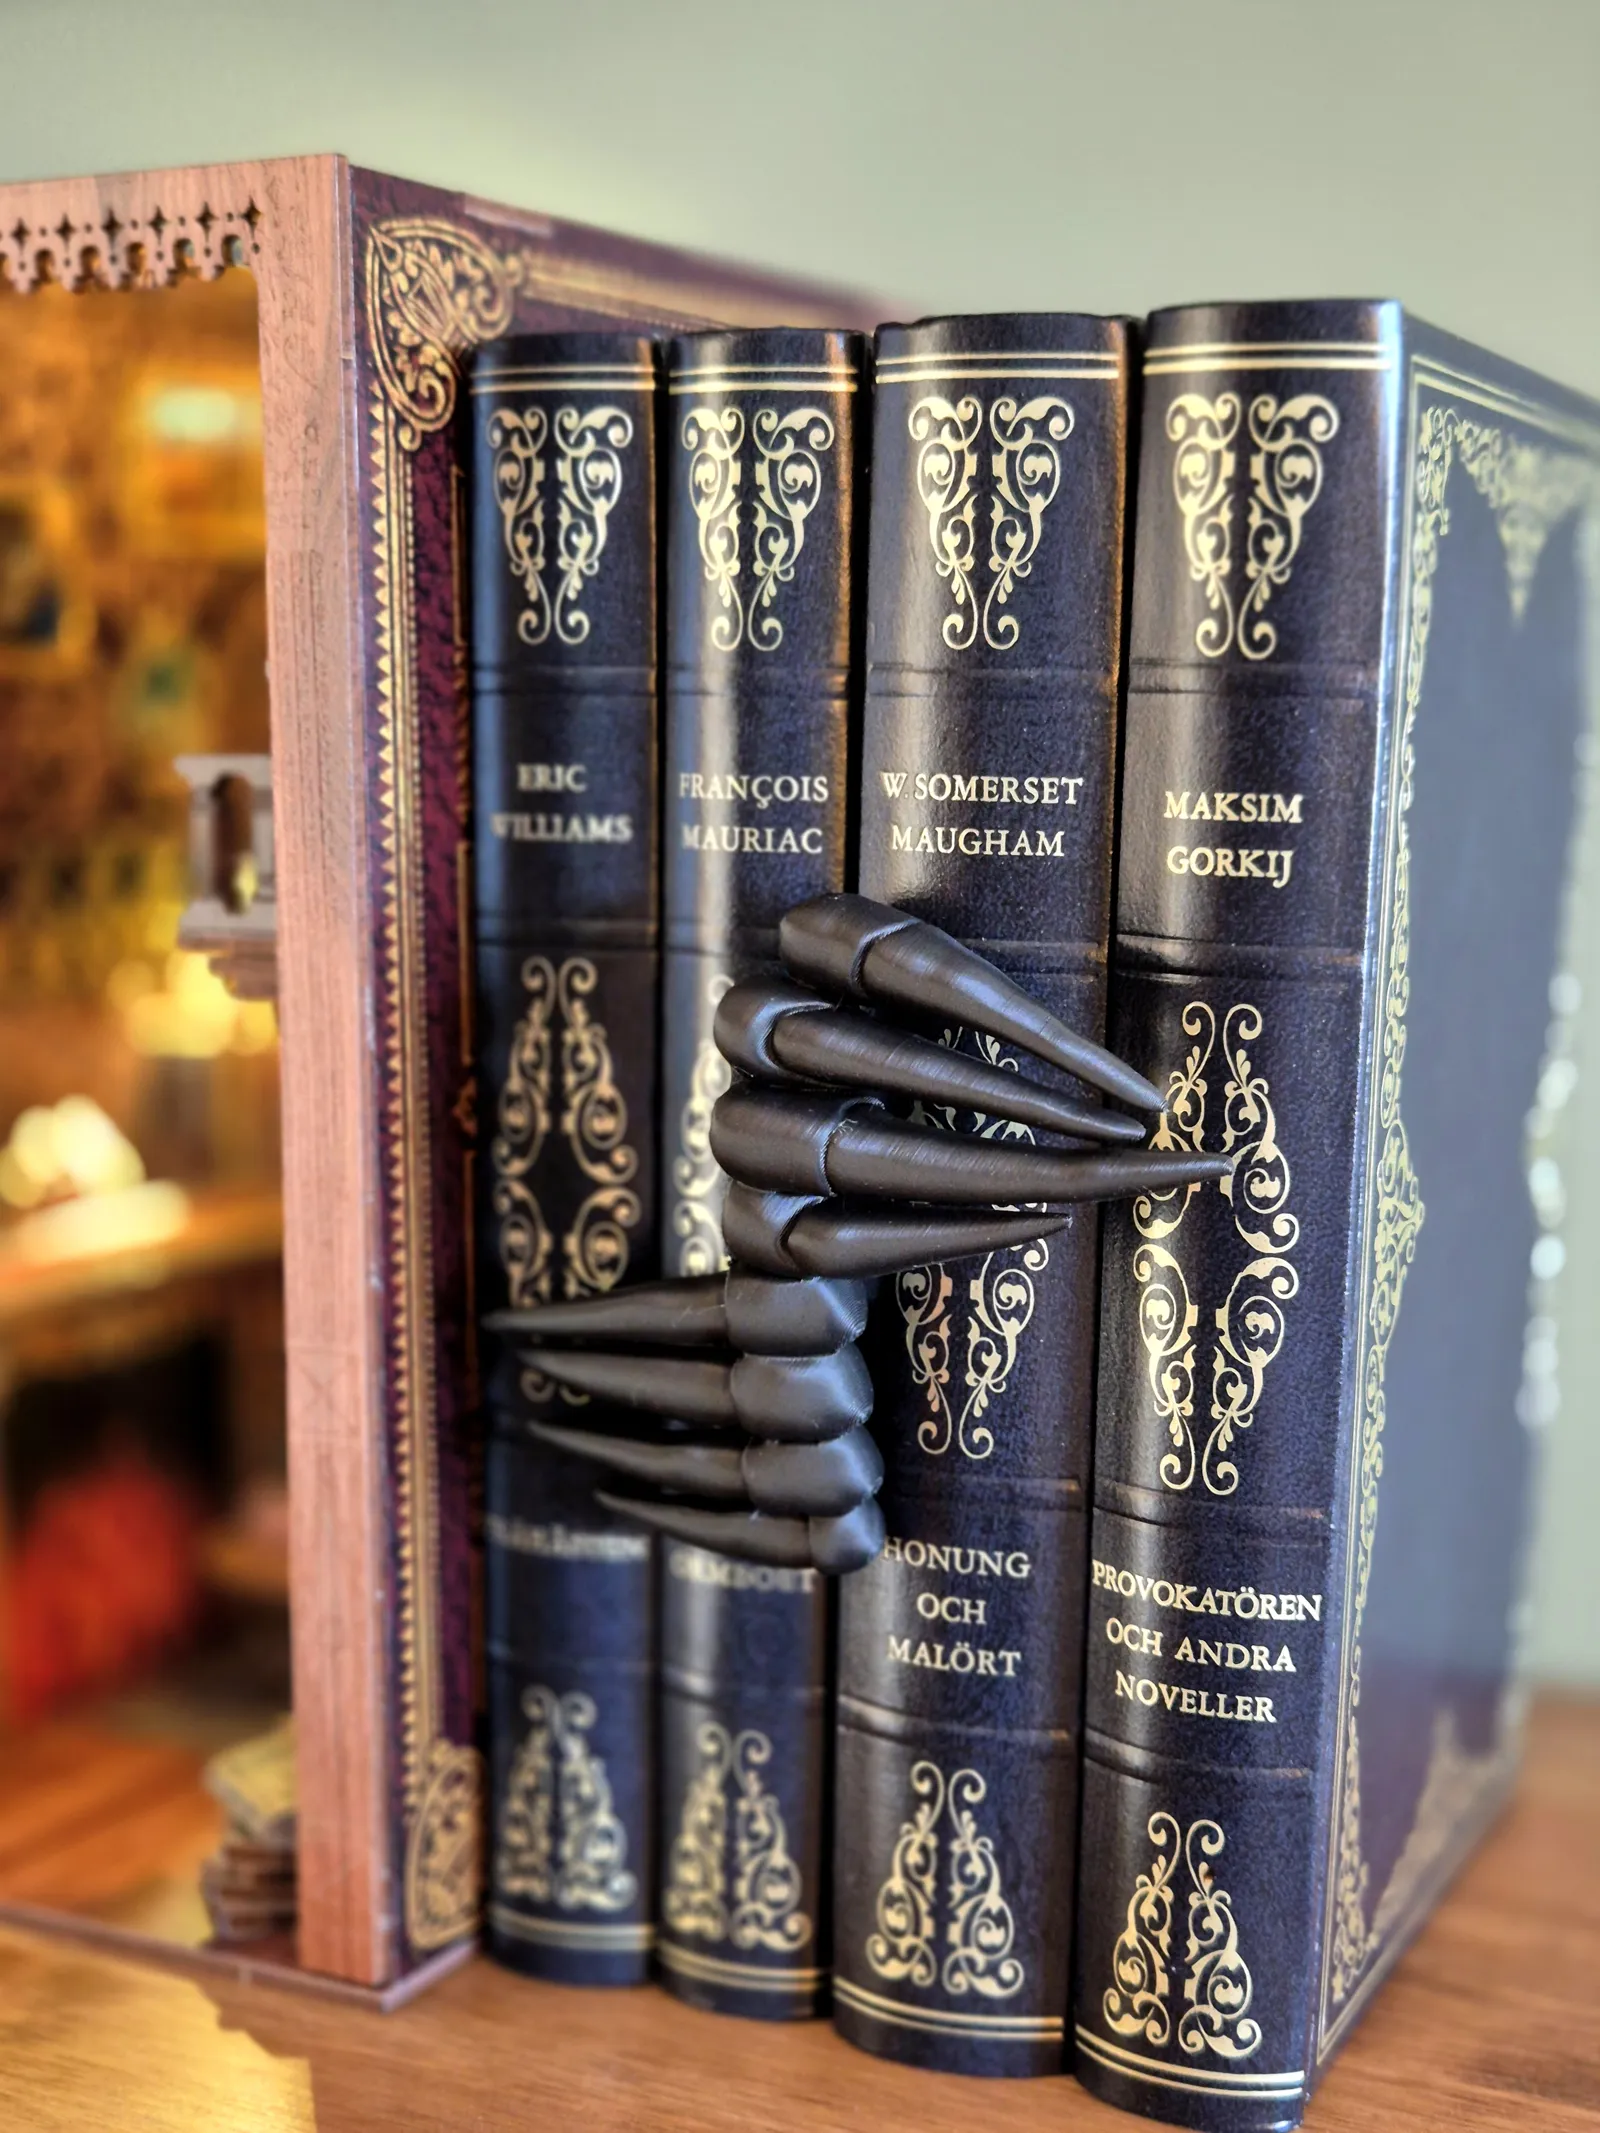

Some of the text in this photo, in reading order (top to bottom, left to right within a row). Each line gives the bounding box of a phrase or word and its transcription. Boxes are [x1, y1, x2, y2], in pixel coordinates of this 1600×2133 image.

[516, 764, 586, 791] ERIC
[678, 773, 828, 808] FRANÇOIS
[881, 772, 1083, 804] W. SOMERSET
[1163, 791, 1302, 823] MAKSIM
[491, 813, 632, 843] WILLIAMS
[682, 822, 822, 853] MAURIAC
[892, 824, 1064, 856] MAUGHAM
[1166, 845, 1293, 888] GORKIJ
[882, 1536, 1031, 1578] HONUNG
[1092, 1560, 1321, 1622] PROVOKATÖREN
[917, 1593, 986, 1624] OCH
[888, 1635, 1021, 1676] MALÖRT
[1106, 1617, 1296, 1672] OCH ANDRA
[1115, 1670, 1276, 1722] NOVELLER
